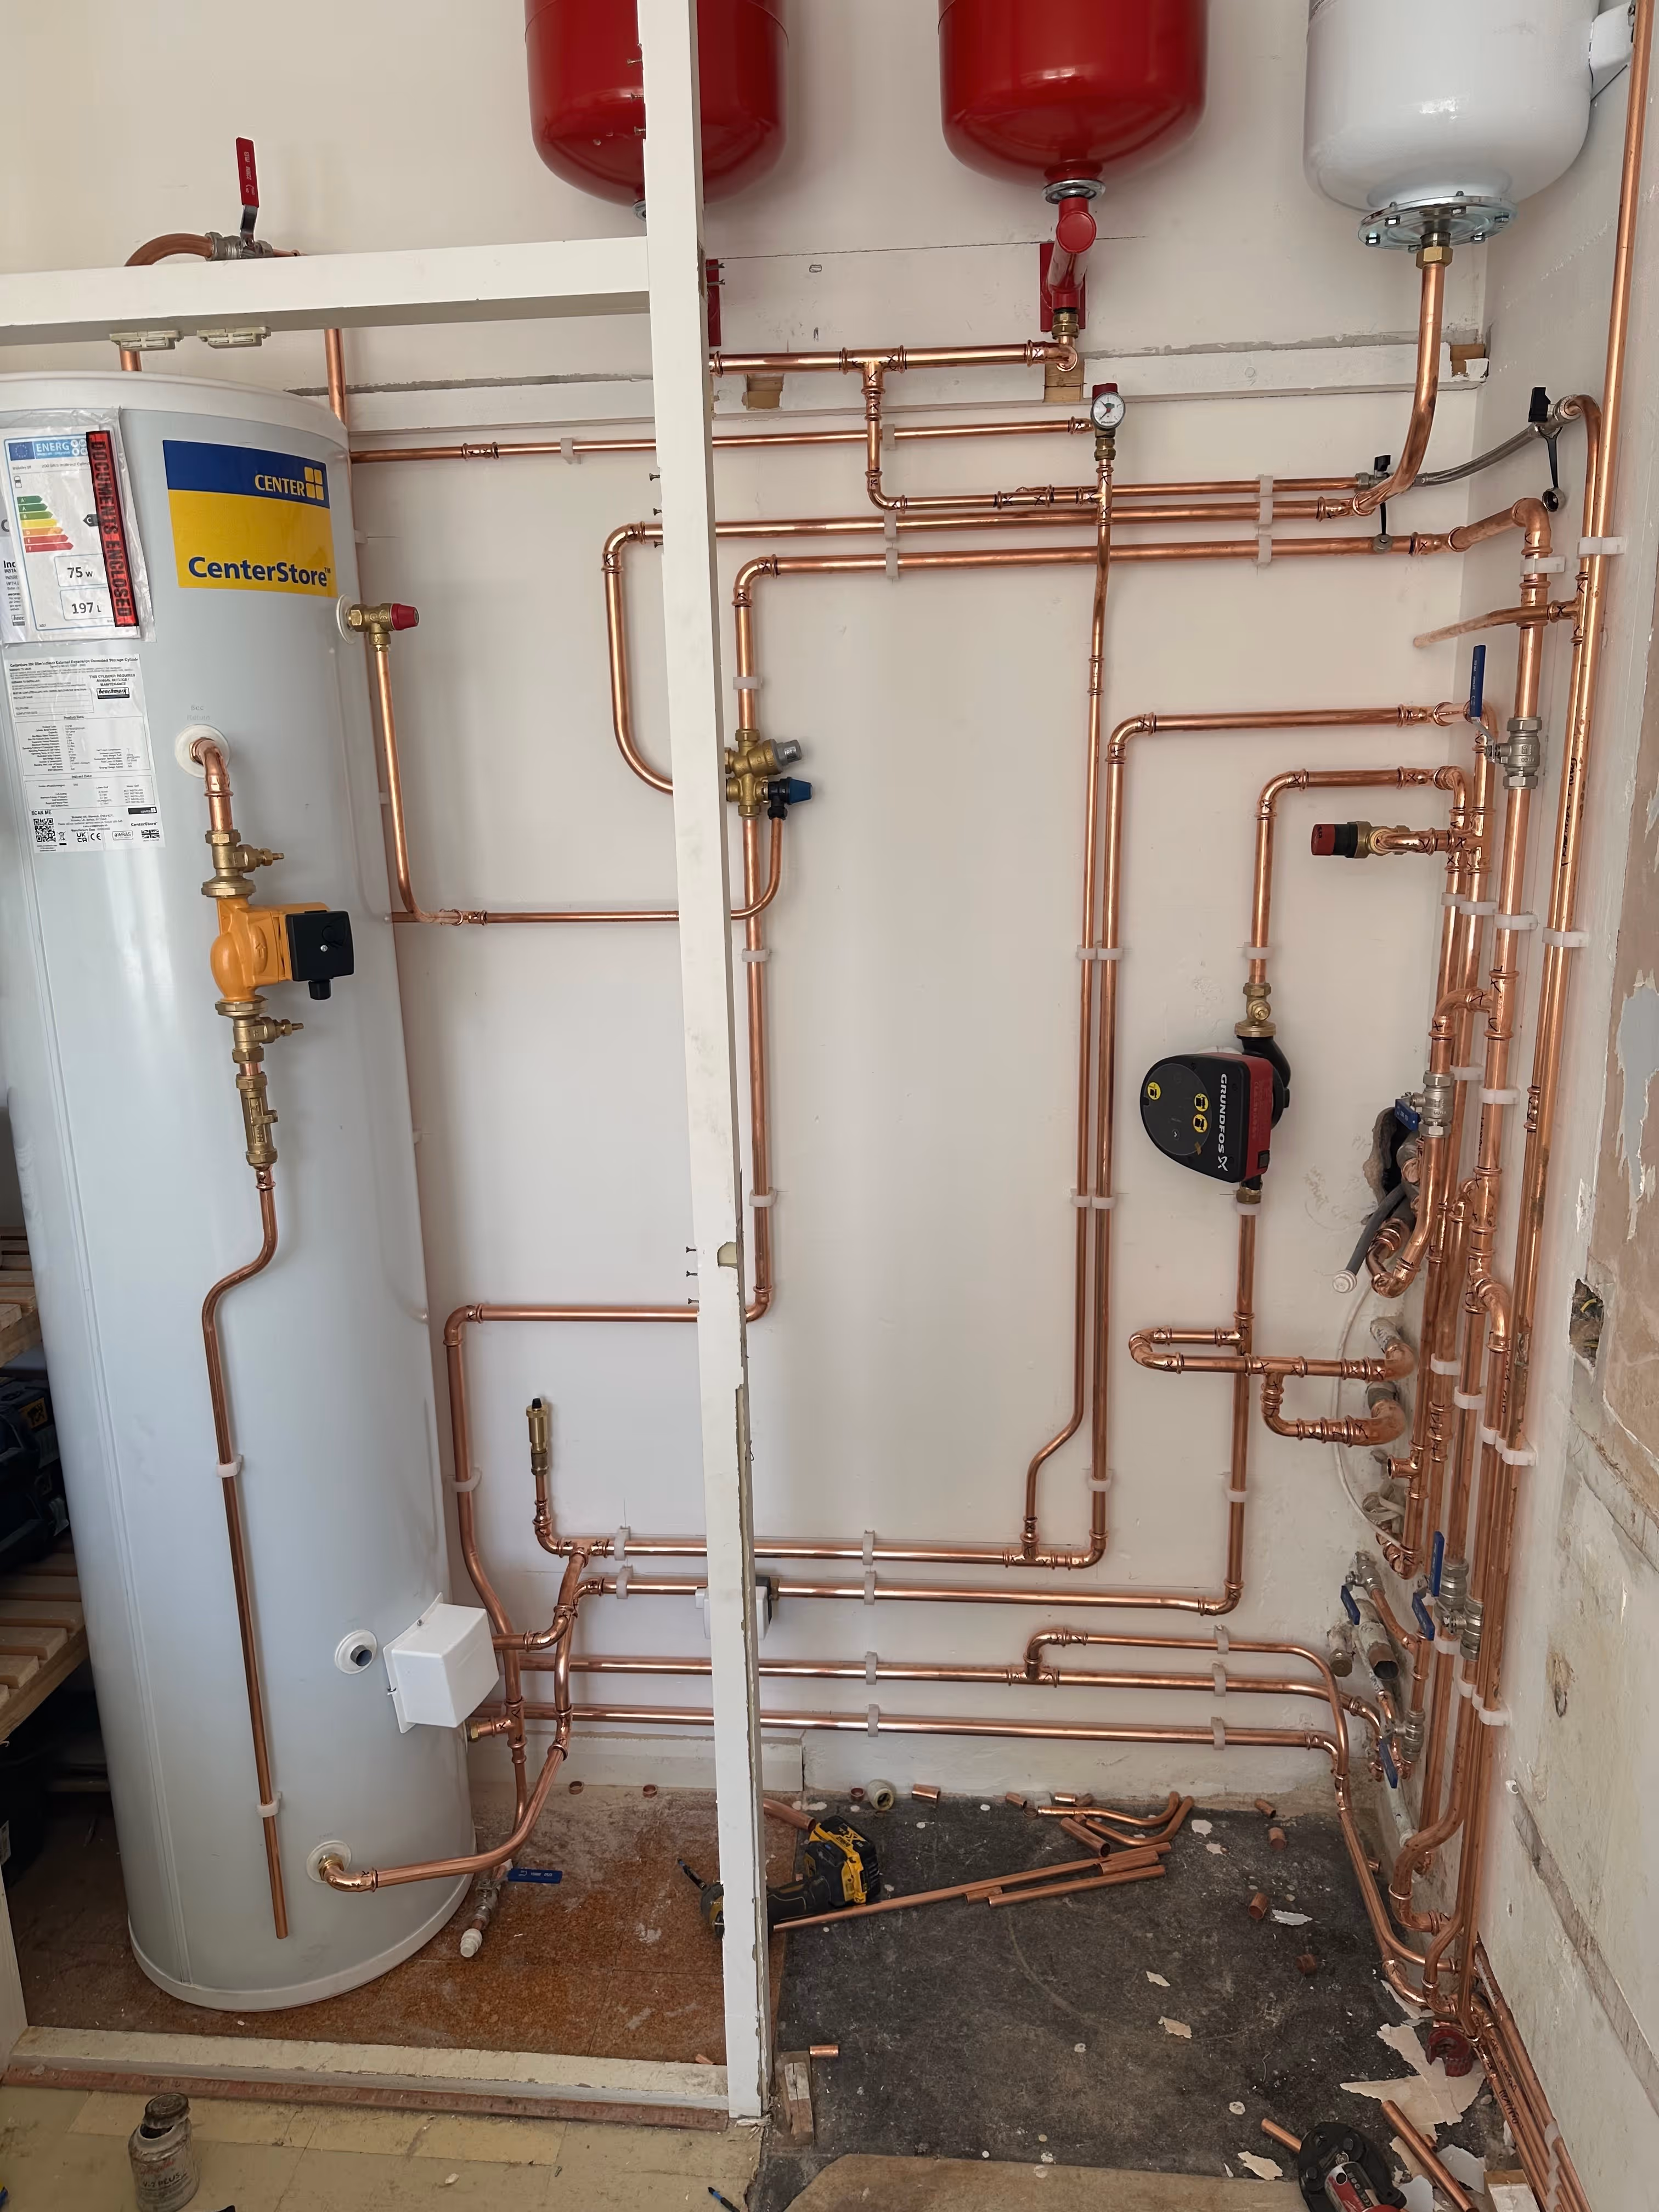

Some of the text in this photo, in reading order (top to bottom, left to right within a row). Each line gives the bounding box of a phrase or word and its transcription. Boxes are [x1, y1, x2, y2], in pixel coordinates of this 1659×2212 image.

[36, 442, 70, 452] ENERG
[91, 441, 119, 534] DOCUMENTS
[255, 474, 306, 496] CENTER
[67, 567, 83, 578] 75
[106, 540, 132, 617] ENCLOSED
[71, 602, 101, 614] 197 L
[1218, 1074, 1227, 1154] GRUNDFOS
